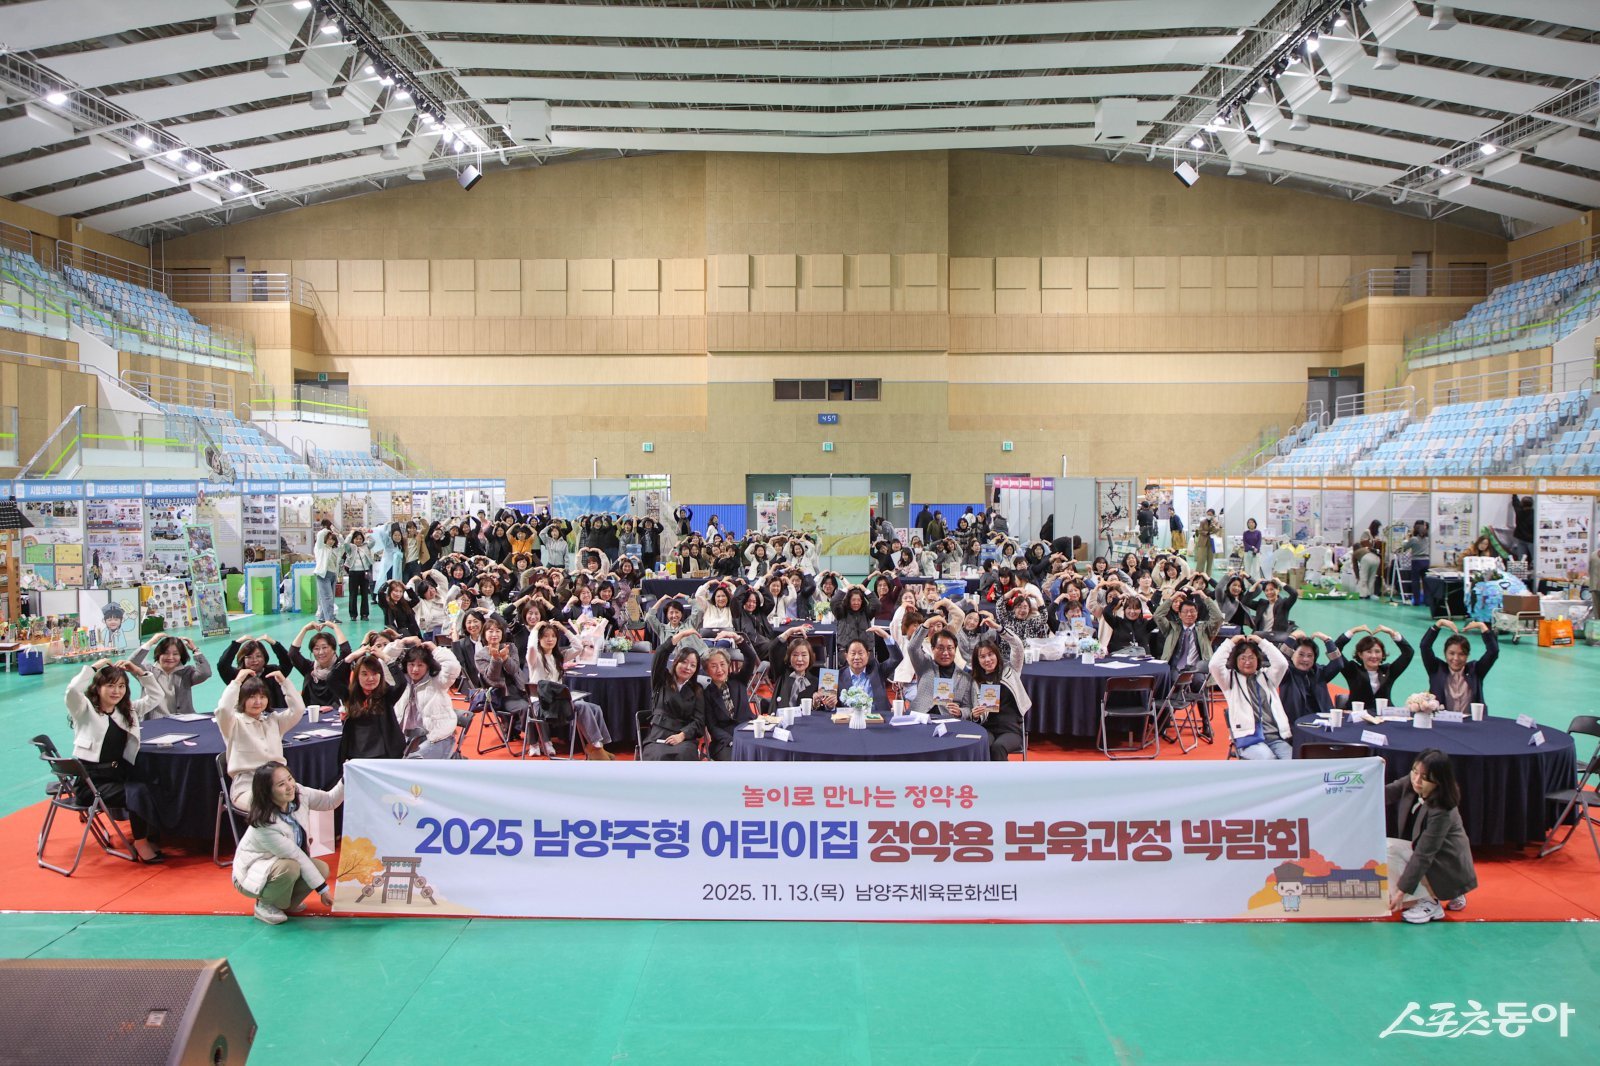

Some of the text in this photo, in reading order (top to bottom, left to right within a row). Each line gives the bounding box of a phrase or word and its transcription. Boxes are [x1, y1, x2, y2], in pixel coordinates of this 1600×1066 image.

[742, 784, 977, 809] 놀이로 만나는 정약용
[415, 817, 1311, 863] 2025 남양주형 어린이집 정약용 보육과정 박람회
[703, 883, 1018, 903] 2025. 11. 13.(목) 남양주체육문화센터
